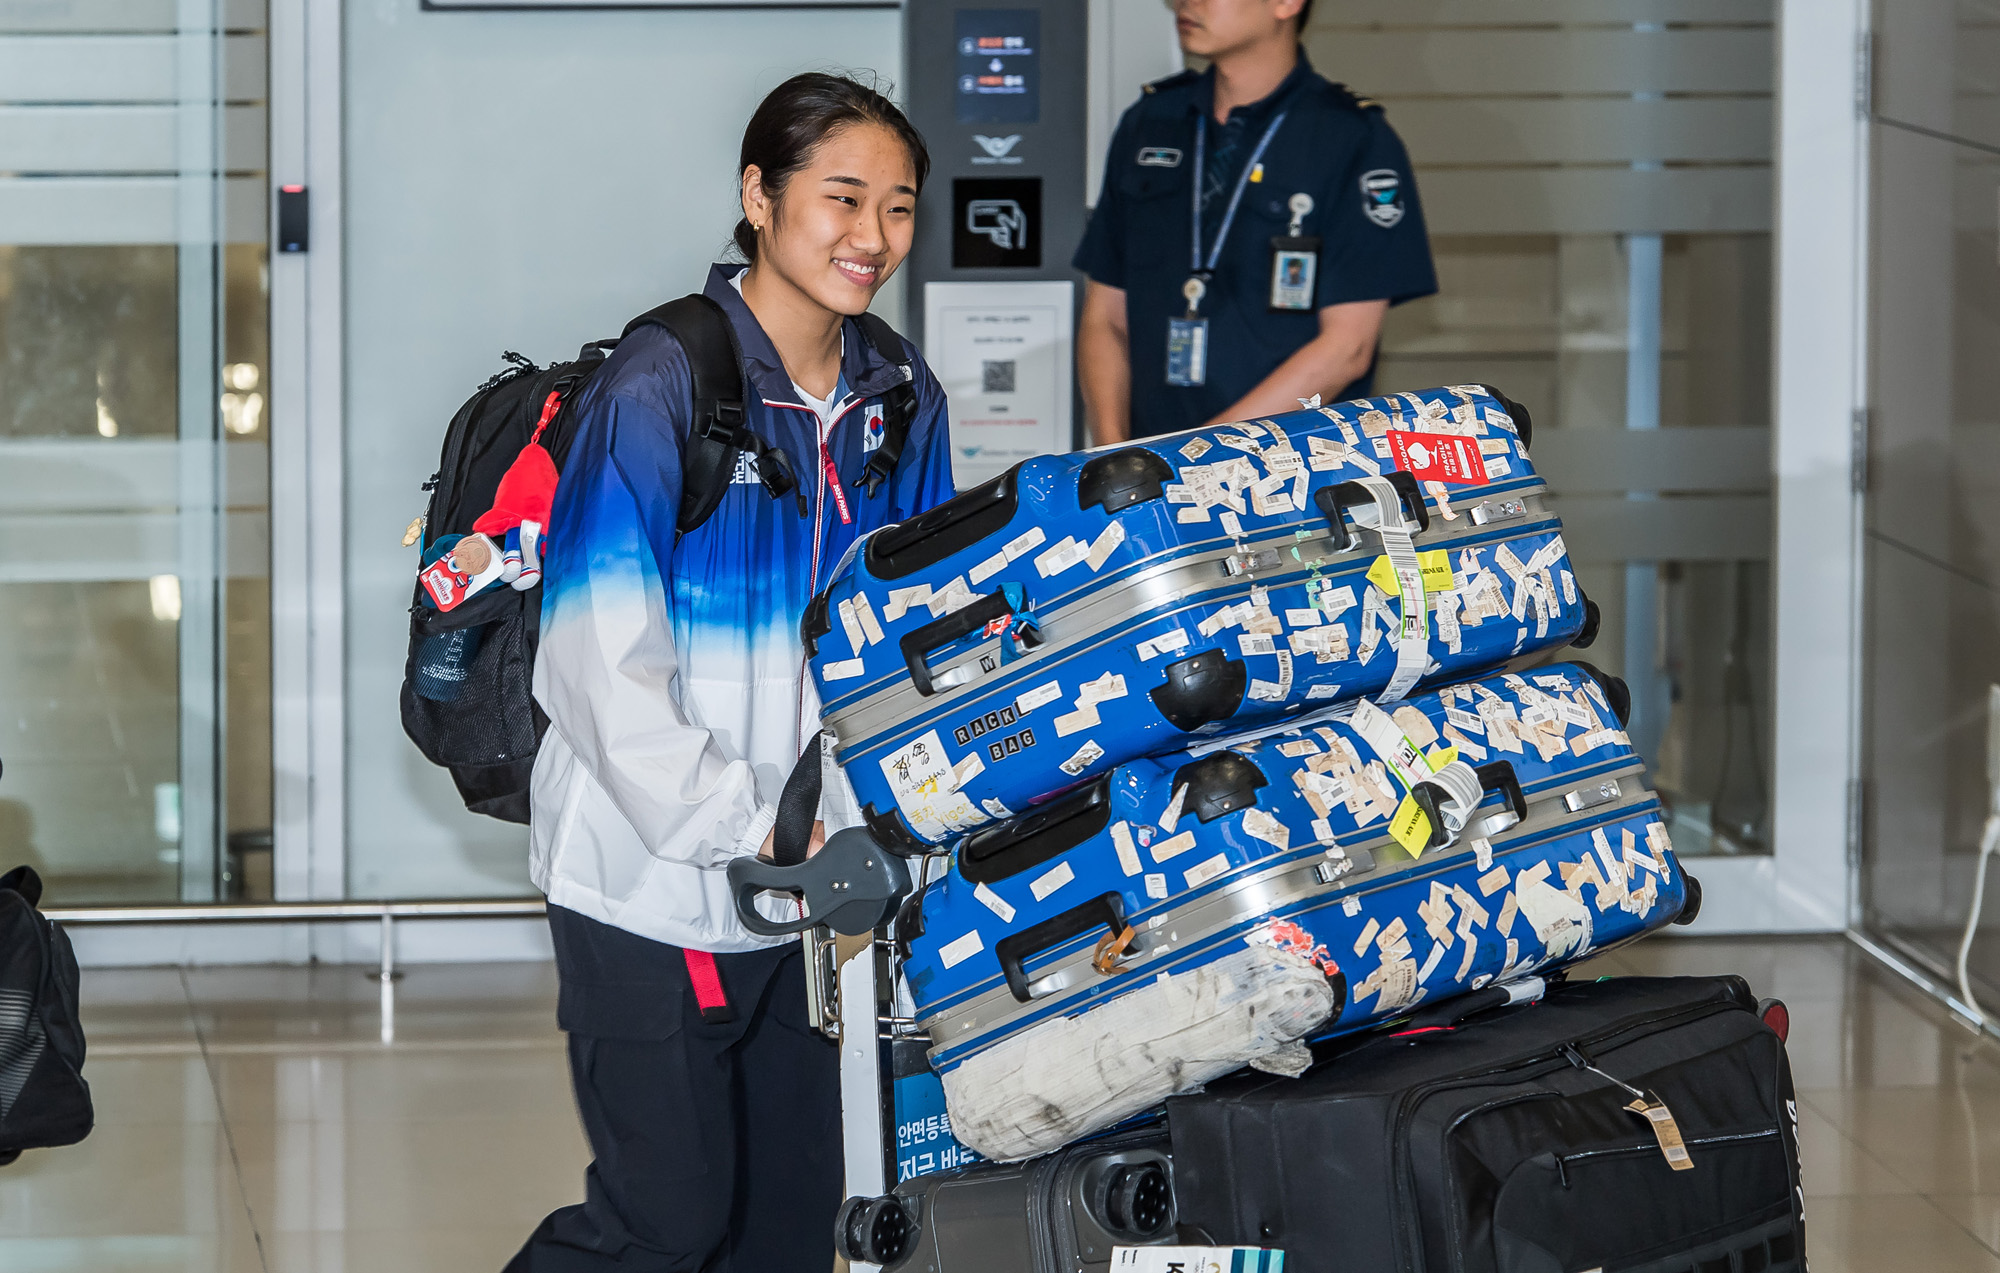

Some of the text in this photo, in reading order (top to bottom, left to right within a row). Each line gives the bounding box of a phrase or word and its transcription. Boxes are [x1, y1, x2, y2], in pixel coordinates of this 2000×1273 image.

[1395, 433, 1412, 472] AGGAGE
[1437, 439, 1453, 477] FRAGILE
[838, 499, 849, 520] PARIS
[980, 657, 995, 672] W
[955, 706, 1018, 746] RACK
[990, 729, 1034, 761] BAG
[934, 803, 968, 825] Vigor
[898, 1113, 952, 1148] 안면등록
